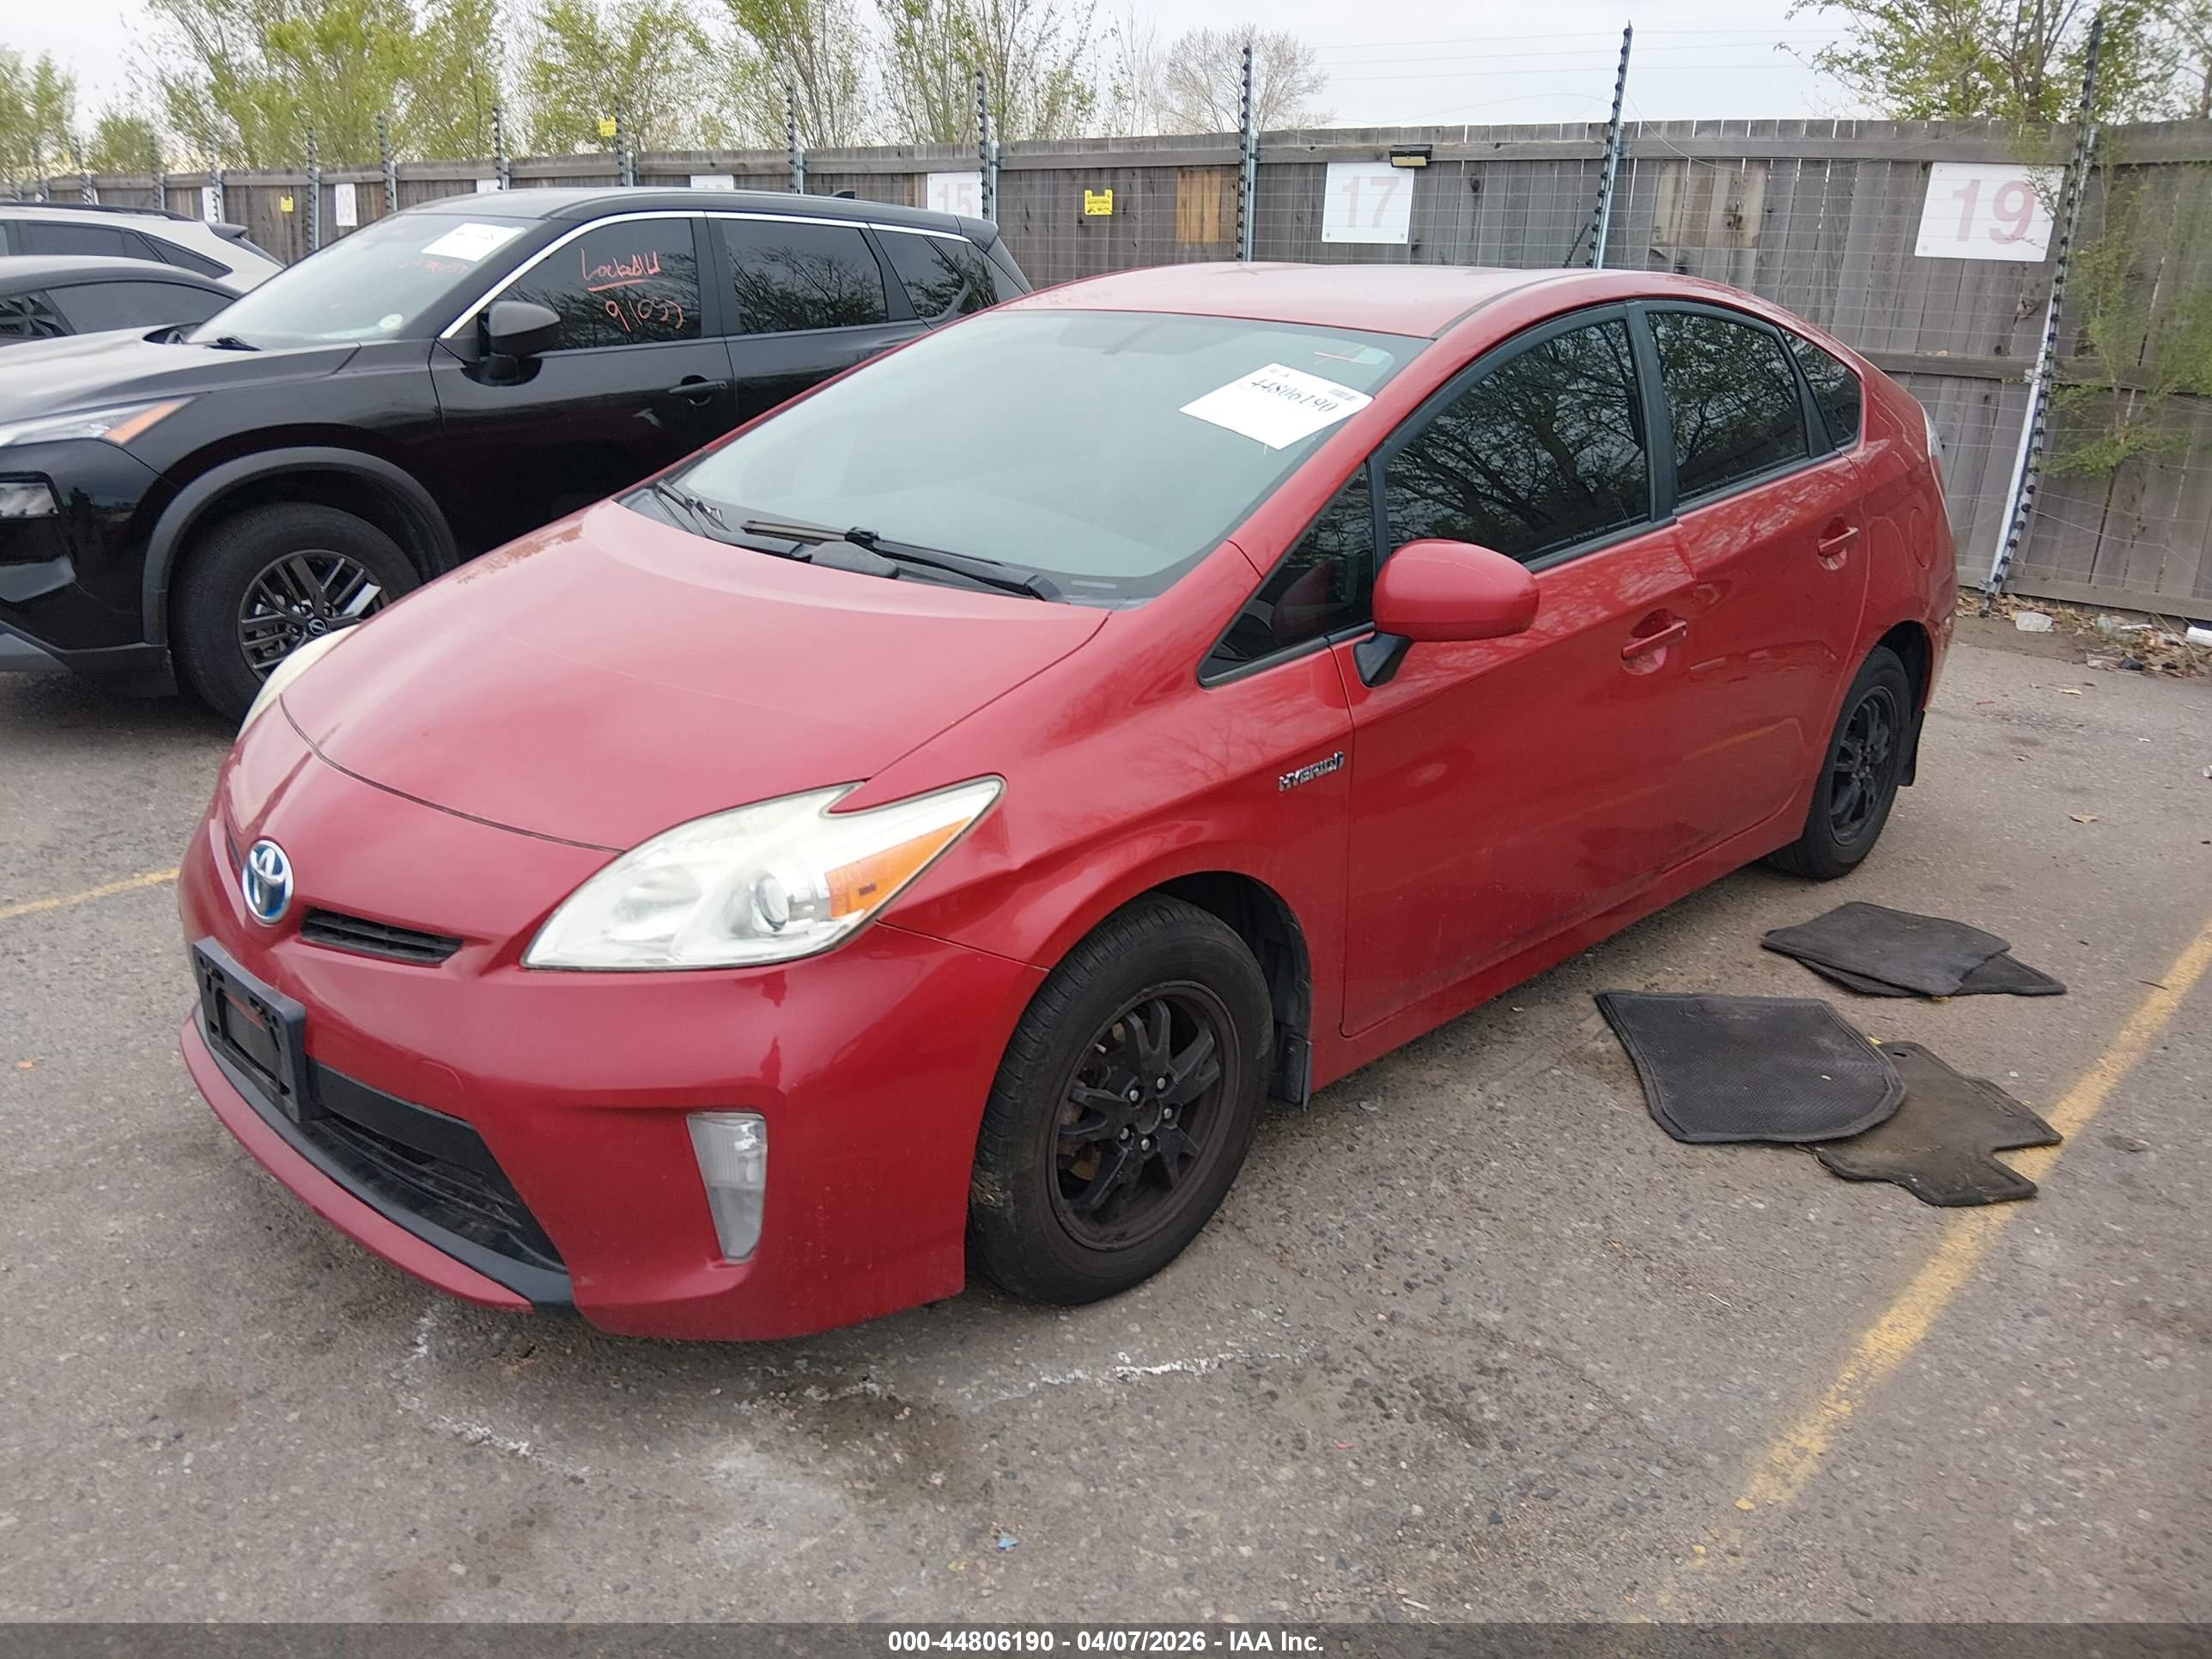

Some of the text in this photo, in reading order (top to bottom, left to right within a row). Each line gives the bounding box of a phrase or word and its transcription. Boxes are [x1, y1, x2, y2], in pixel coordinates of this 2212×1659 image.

[938, 182, 975, 216] 15
[1342, 176, 1400, 228] 17
[1952, 179, 2035, 244] 19
[1278, 750, 1346, 792] HYBRID
